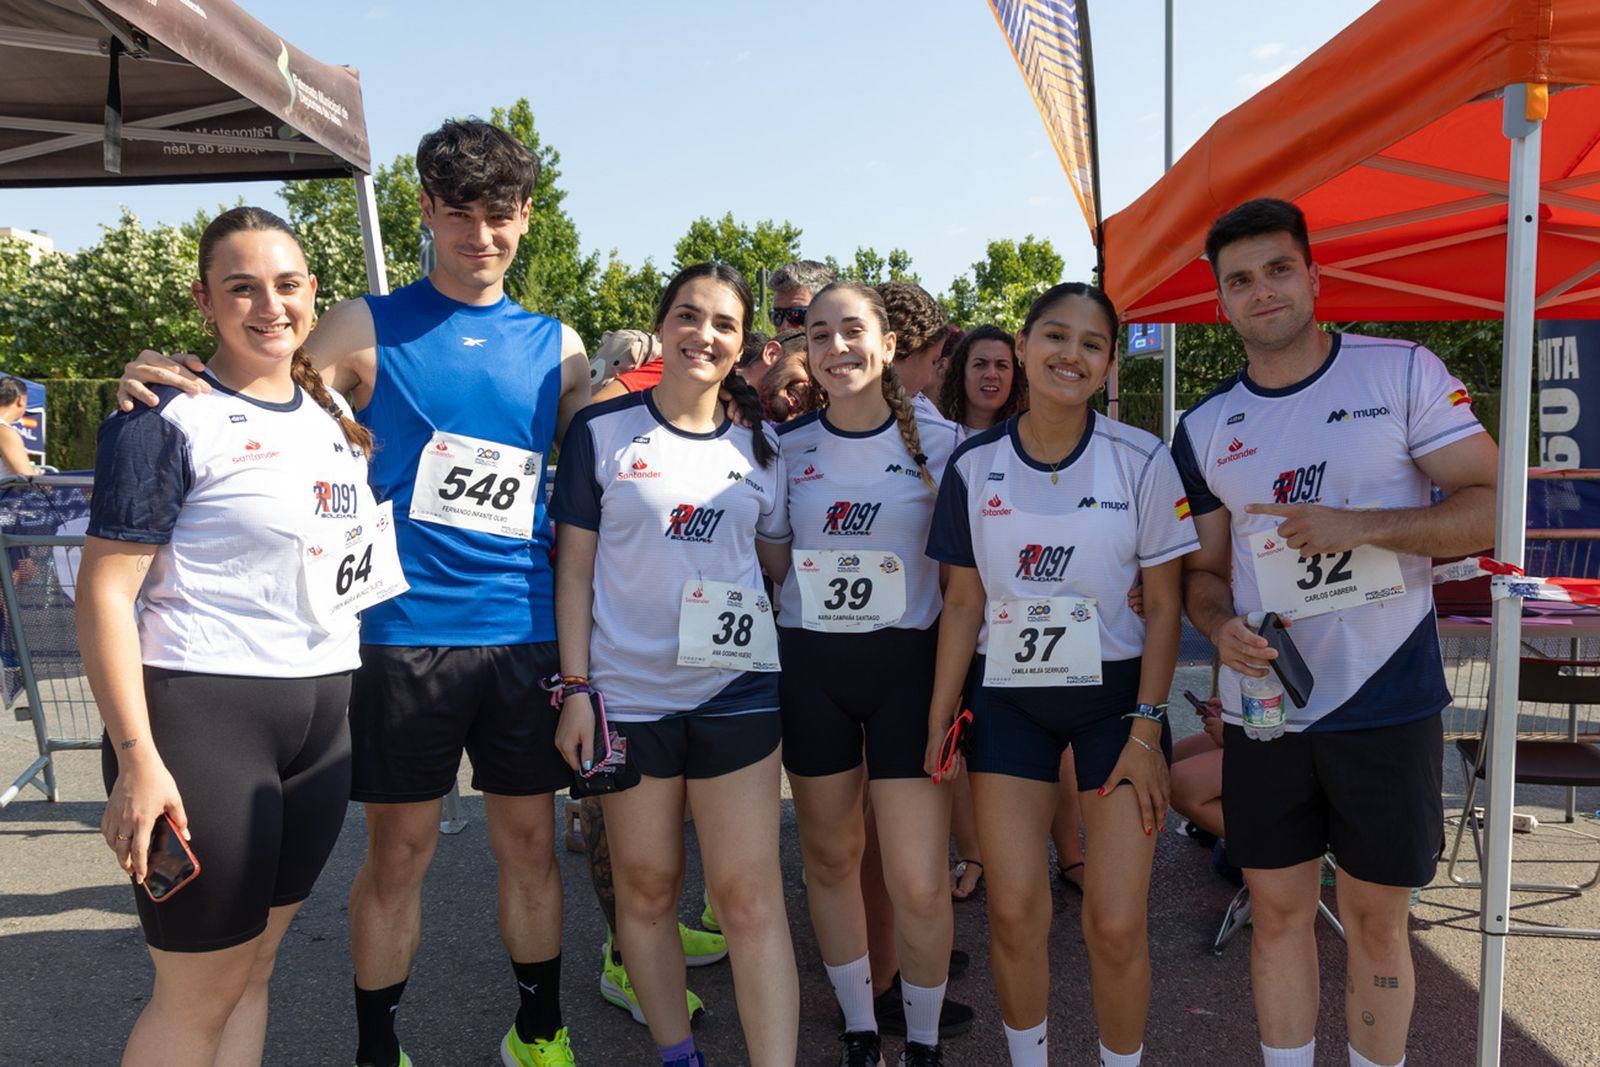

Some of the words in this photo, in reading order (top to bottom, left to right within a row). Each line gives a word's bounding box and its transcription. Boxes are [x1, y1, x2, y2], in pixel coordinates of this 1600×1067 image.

[231, 450, 281, 465] Santander
[1216, 447, 1258, 467] Santander
[438, 466, 520, 510] 548
[618, 471, 662, 480] Santander
[1100, 500, 1129, 512] mupol
[336, 543, 373, 596] 64
[1296, 550, 1353, 591] 32
[824, 577, 873, 610] 39
[1304, 591, 1329, 603] CARLOS
[1329, 585, 1357, 598] CABRERA
[712, 611, 754, 647] 38
[1014, 626, 1067, 663] 37
